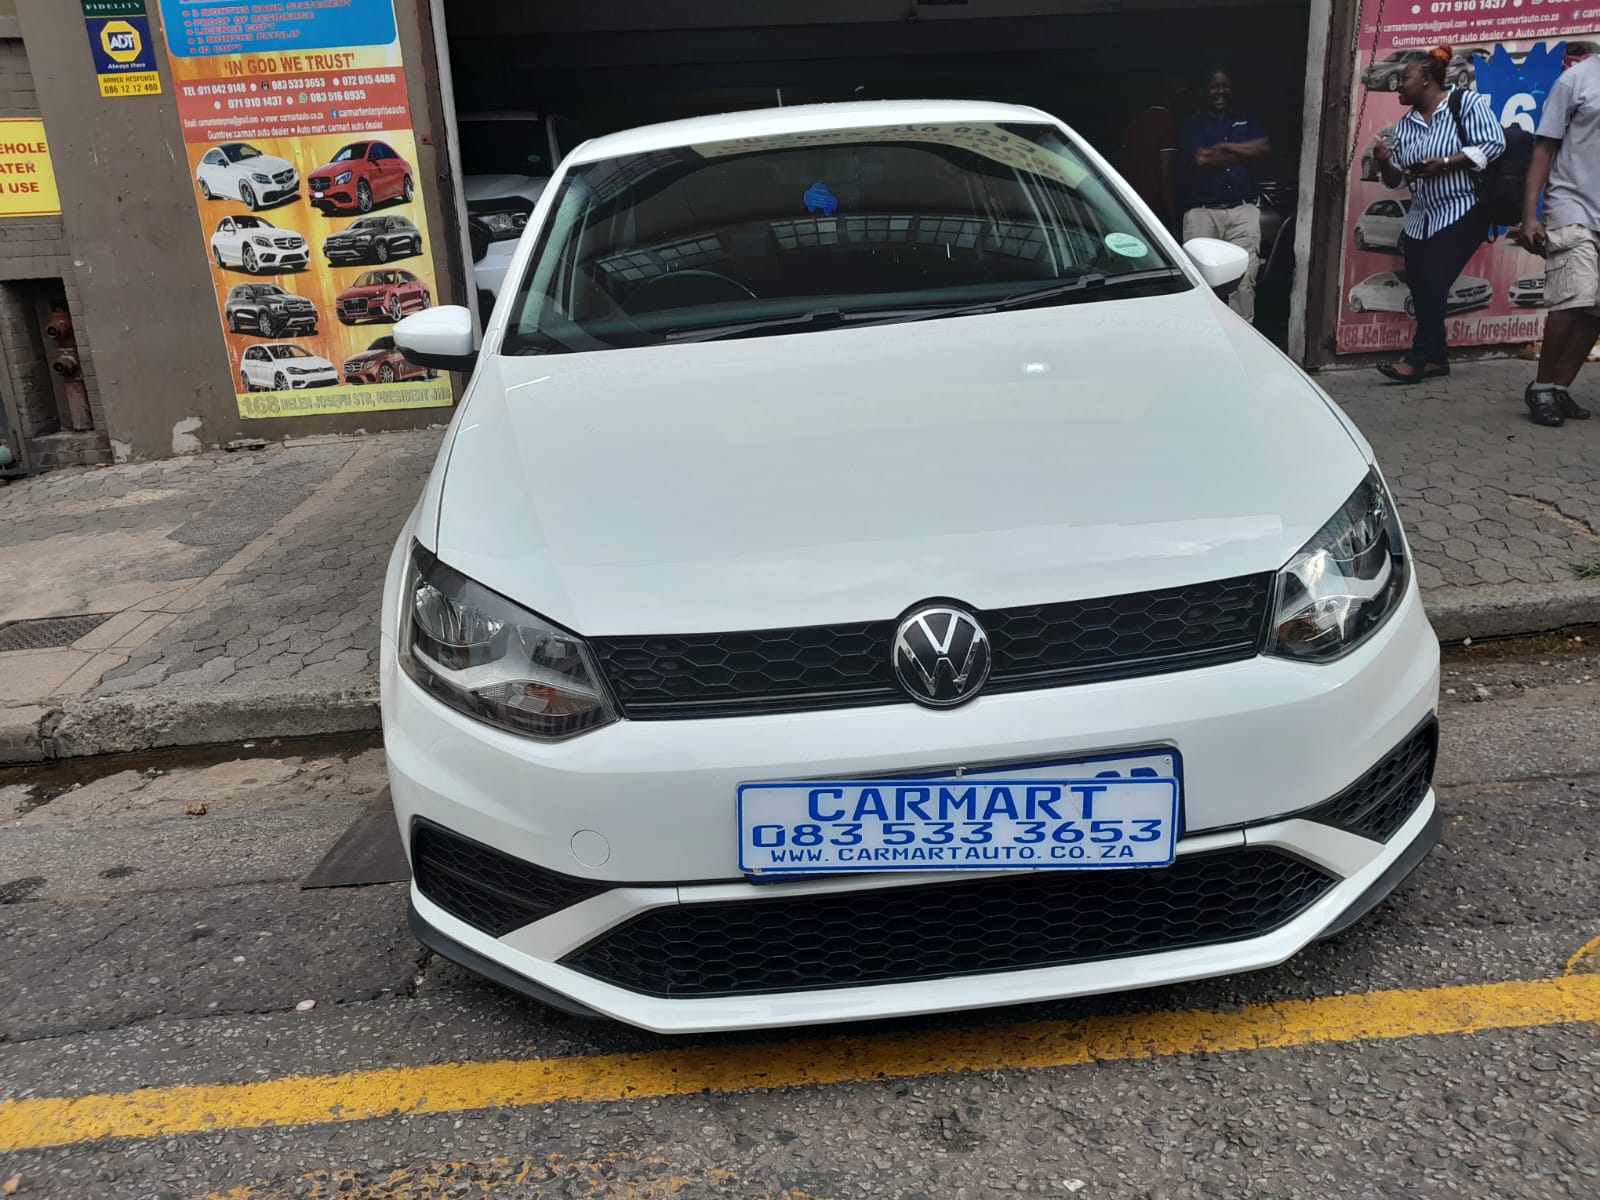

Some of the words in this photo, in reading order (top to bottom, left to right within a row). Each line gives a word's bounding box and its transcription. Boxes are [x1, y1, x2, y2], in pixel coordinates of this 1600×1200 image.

[85, 2, 140, 10] FIDELITY
[202, 6, 249, 16] MONTHS
[252, 4, 283, 12] BANK
[286, 0, 352, 10] STATEMENT
[1431, 2, 1452, 13] 071
[1454, 0, 1477, 12] 910
[1479, 0, 1507, 10] 1437
[193, 17, 230, 26] PROOF
[234, 16, 247, 24] OF
[251, 11, 314, 22] RESIDENCE
[195, 25, 242, 35] LICENCE
[246, 23, 275, 32] COPY
[207, 34, 253, 43] MONTHS
[256, 30, 301, 39] PAYSLIP
[1459, 32, 1478, 42] auto
[1479, 29, 1504, 41] dealer
[1515, 27, 1535, 38] Auto
[1536, 26, 1559, 36] mart:
[1560, 23, 1593, 34] carmart
[110, 33, 134, 49] ADT
[199, 46, 210, 54] ID
[213, 44, 242, 52] COPY
[247, 58, 277, 73] GOD
[280, 56, 302, 72] WE
[125, 74, 156, 82] RESPONSE
[212, 84, 227, 94] 042
[271, 80, 287, 90] 083
[288, 79, 304, 90] 533
[305, 77, 325, 89] 3653
[342, 76, 357, 86] 072
[358, 75, 373, 85] 015
[374, 73, 396, 84] 4488
[104, 85, 119, 94] 086
[121, 85, 130, 93] 12
[132, 84, 141, 92] 12
[144, 83, 158, 91] 400
[228, 98, 243, 109] 071
[244, 97, 261, 108] 910
[262, 96, 282, 107] 1437
[310, 92, 326, 103] 083
[327, 91, 343, 102] 516
[343, 90, 366, 101] 0935
[257, 128, 271, 136] auto
[271, 125, 289, 135] dealer
[297, 124, 311, 134] Auto
[327, 123, 351, 132] carmart
[351, 122, 364, 130] auto
[365, 120, 383, 129] dealer
[8, 182, 40, 194] USE
[1338, 325, 1359, 346] 168
[1452, 320, 1472, 340] Str.
[1477, 316, 1539, 341] (president
[241, 395, 281, 415] 168
[280, 396, 313, 410] HELEN
[314, 393, 352, 408] JOSEPH
[352, 391, 376, 407] STR,
[376, 388, 429, 403] PRESIDENT
[808, 785, 1108, 823] CARMART
[752, 822, 864, 848] 083
[882, 821, 993, 847] 533
[1013, 819, 1162, 845] 3653
